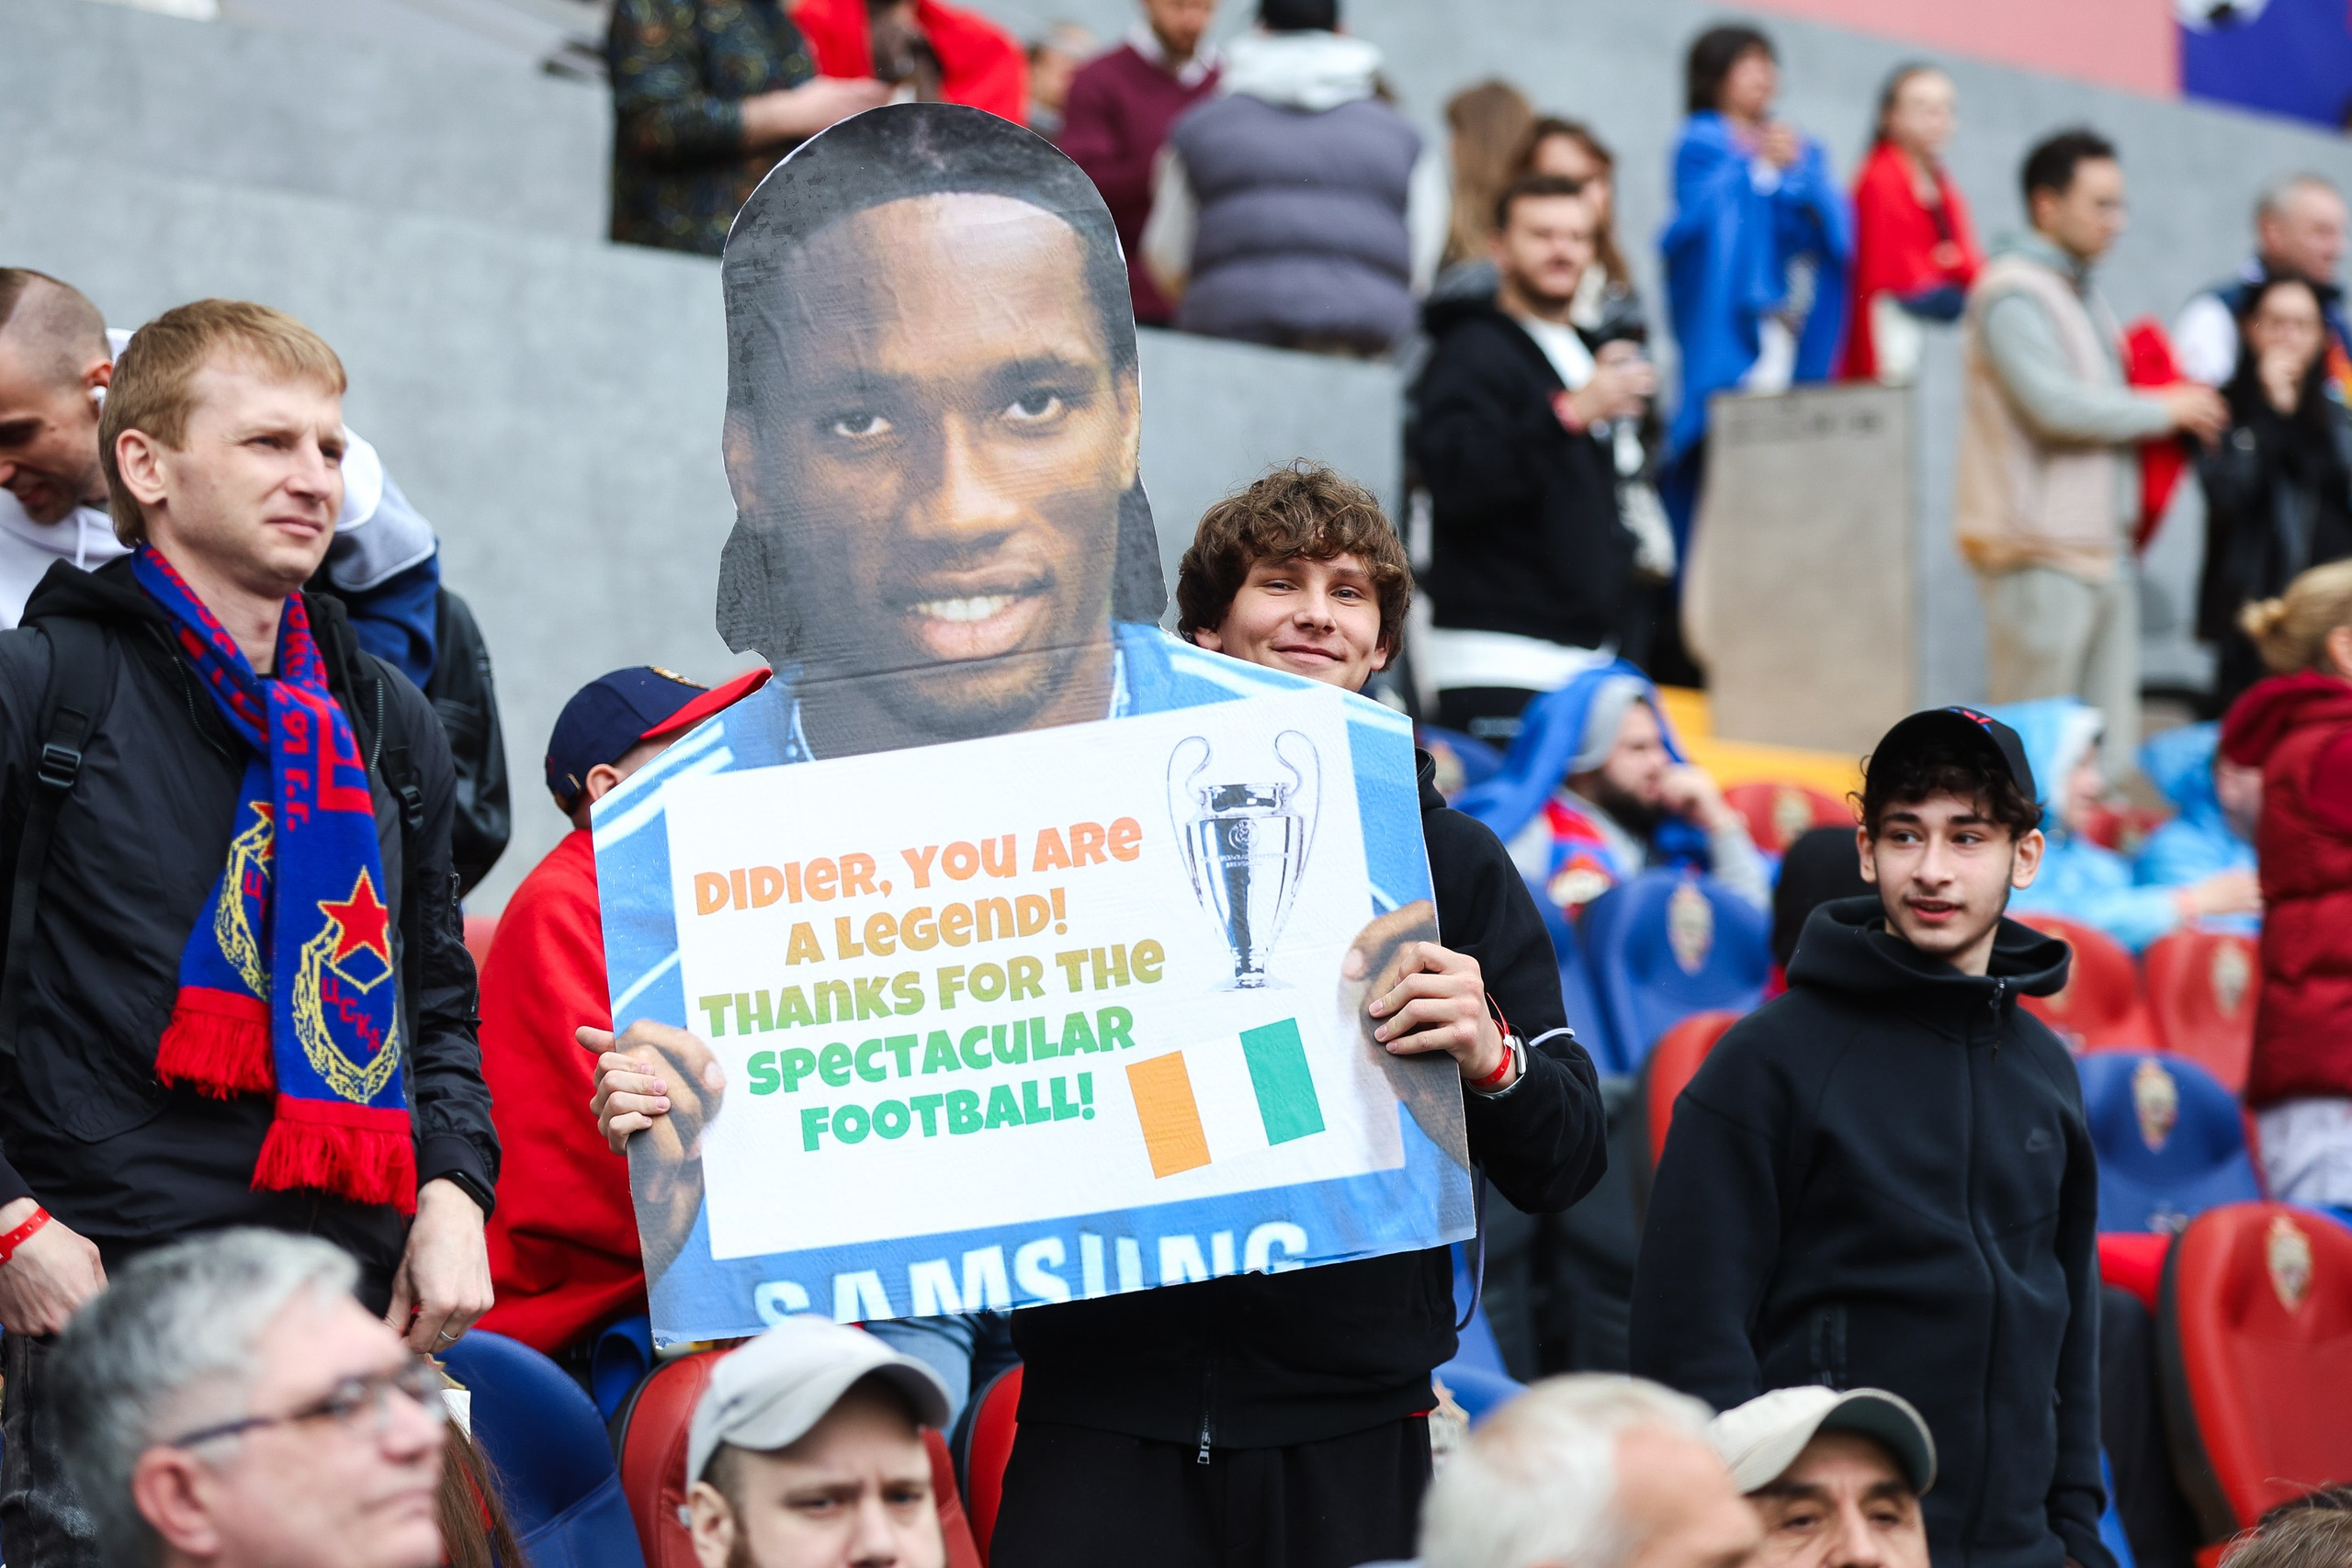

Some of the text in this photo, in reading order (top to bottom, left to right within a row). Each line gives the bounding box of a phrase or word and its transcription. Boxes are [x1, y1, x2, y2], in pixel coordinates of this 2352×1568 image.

[899, 834, 1017, 889] YOU
[785, 921, 825, 965] A
[937, 955, 1046, 1010] FOR
[322, 976, 380, 1052] ЦСКА
[800, 1071, 1096, 1153] FOOTBALL!
